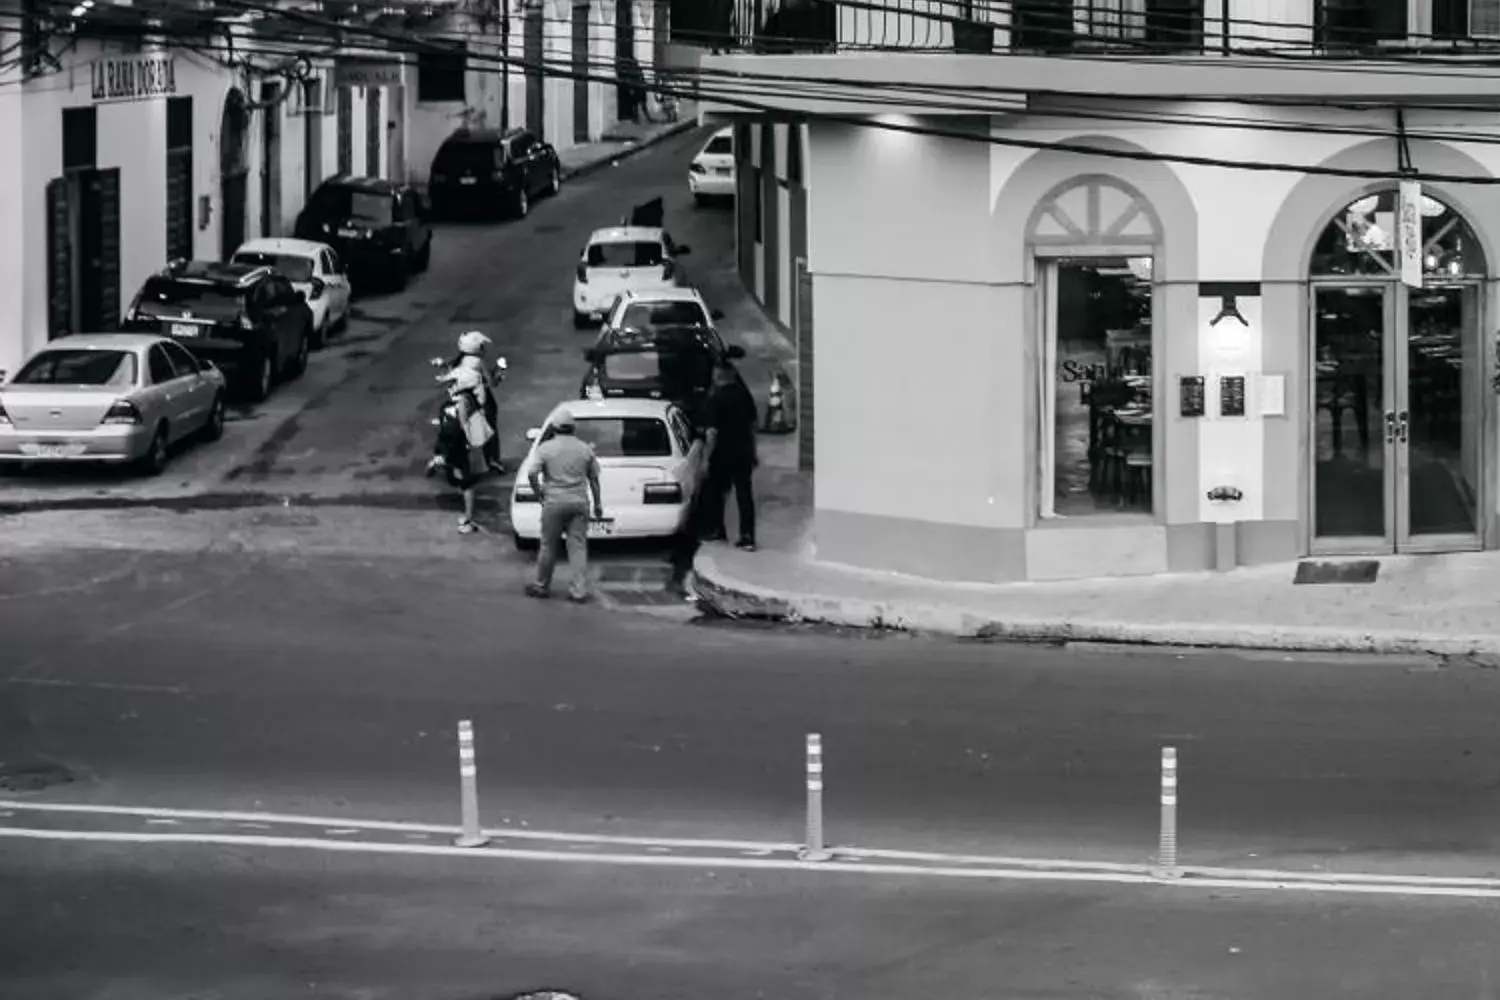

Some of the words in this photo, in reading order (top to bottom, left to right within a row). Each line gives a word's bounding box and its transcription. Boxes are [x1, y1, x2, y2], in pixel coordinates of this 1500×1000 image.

[91, 61, 105, 99] LA
[107, 61, 134, 97] RANA
[136, 59, 176, 95] DORADA
